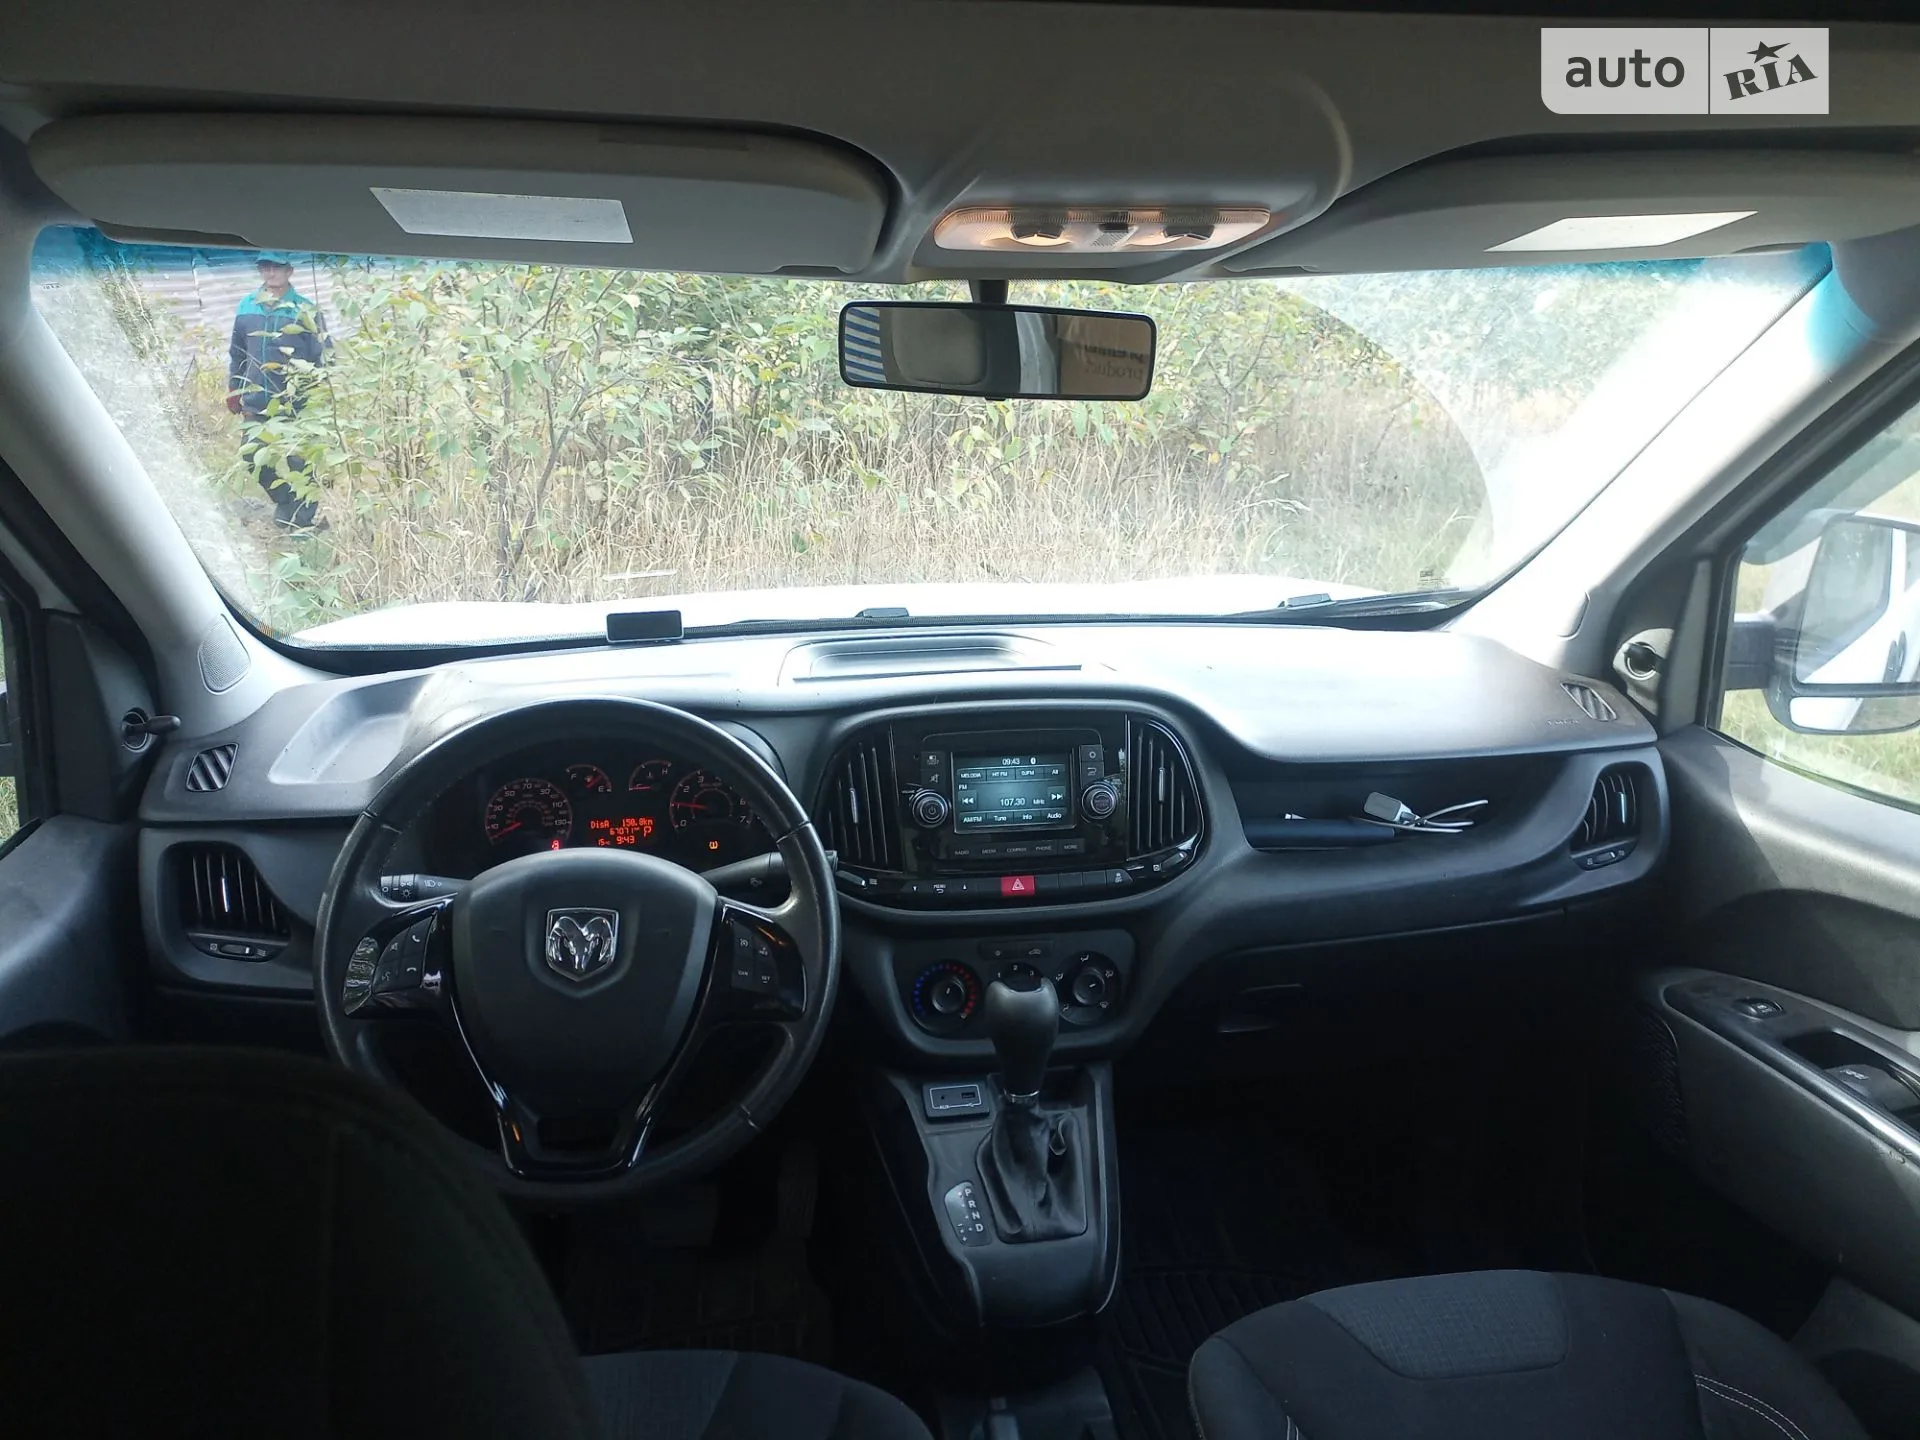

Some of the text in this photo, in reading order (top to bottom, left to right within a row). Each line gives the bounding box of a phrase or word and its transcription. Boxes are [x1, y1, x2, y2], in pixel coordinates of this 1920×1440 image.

[1002, 757, 1020, 765] 09:43
[1000, 798, 1025, 806] 107.30
[644, 826, 652, 836] P
[616, 836, 635, 844] 9:43
[964, 1188, 972, 1196] P
[968, 1200, 976, 1208] R
[972, 1211, 981, 1220] N
[975, 1223, 984, 1232] D
